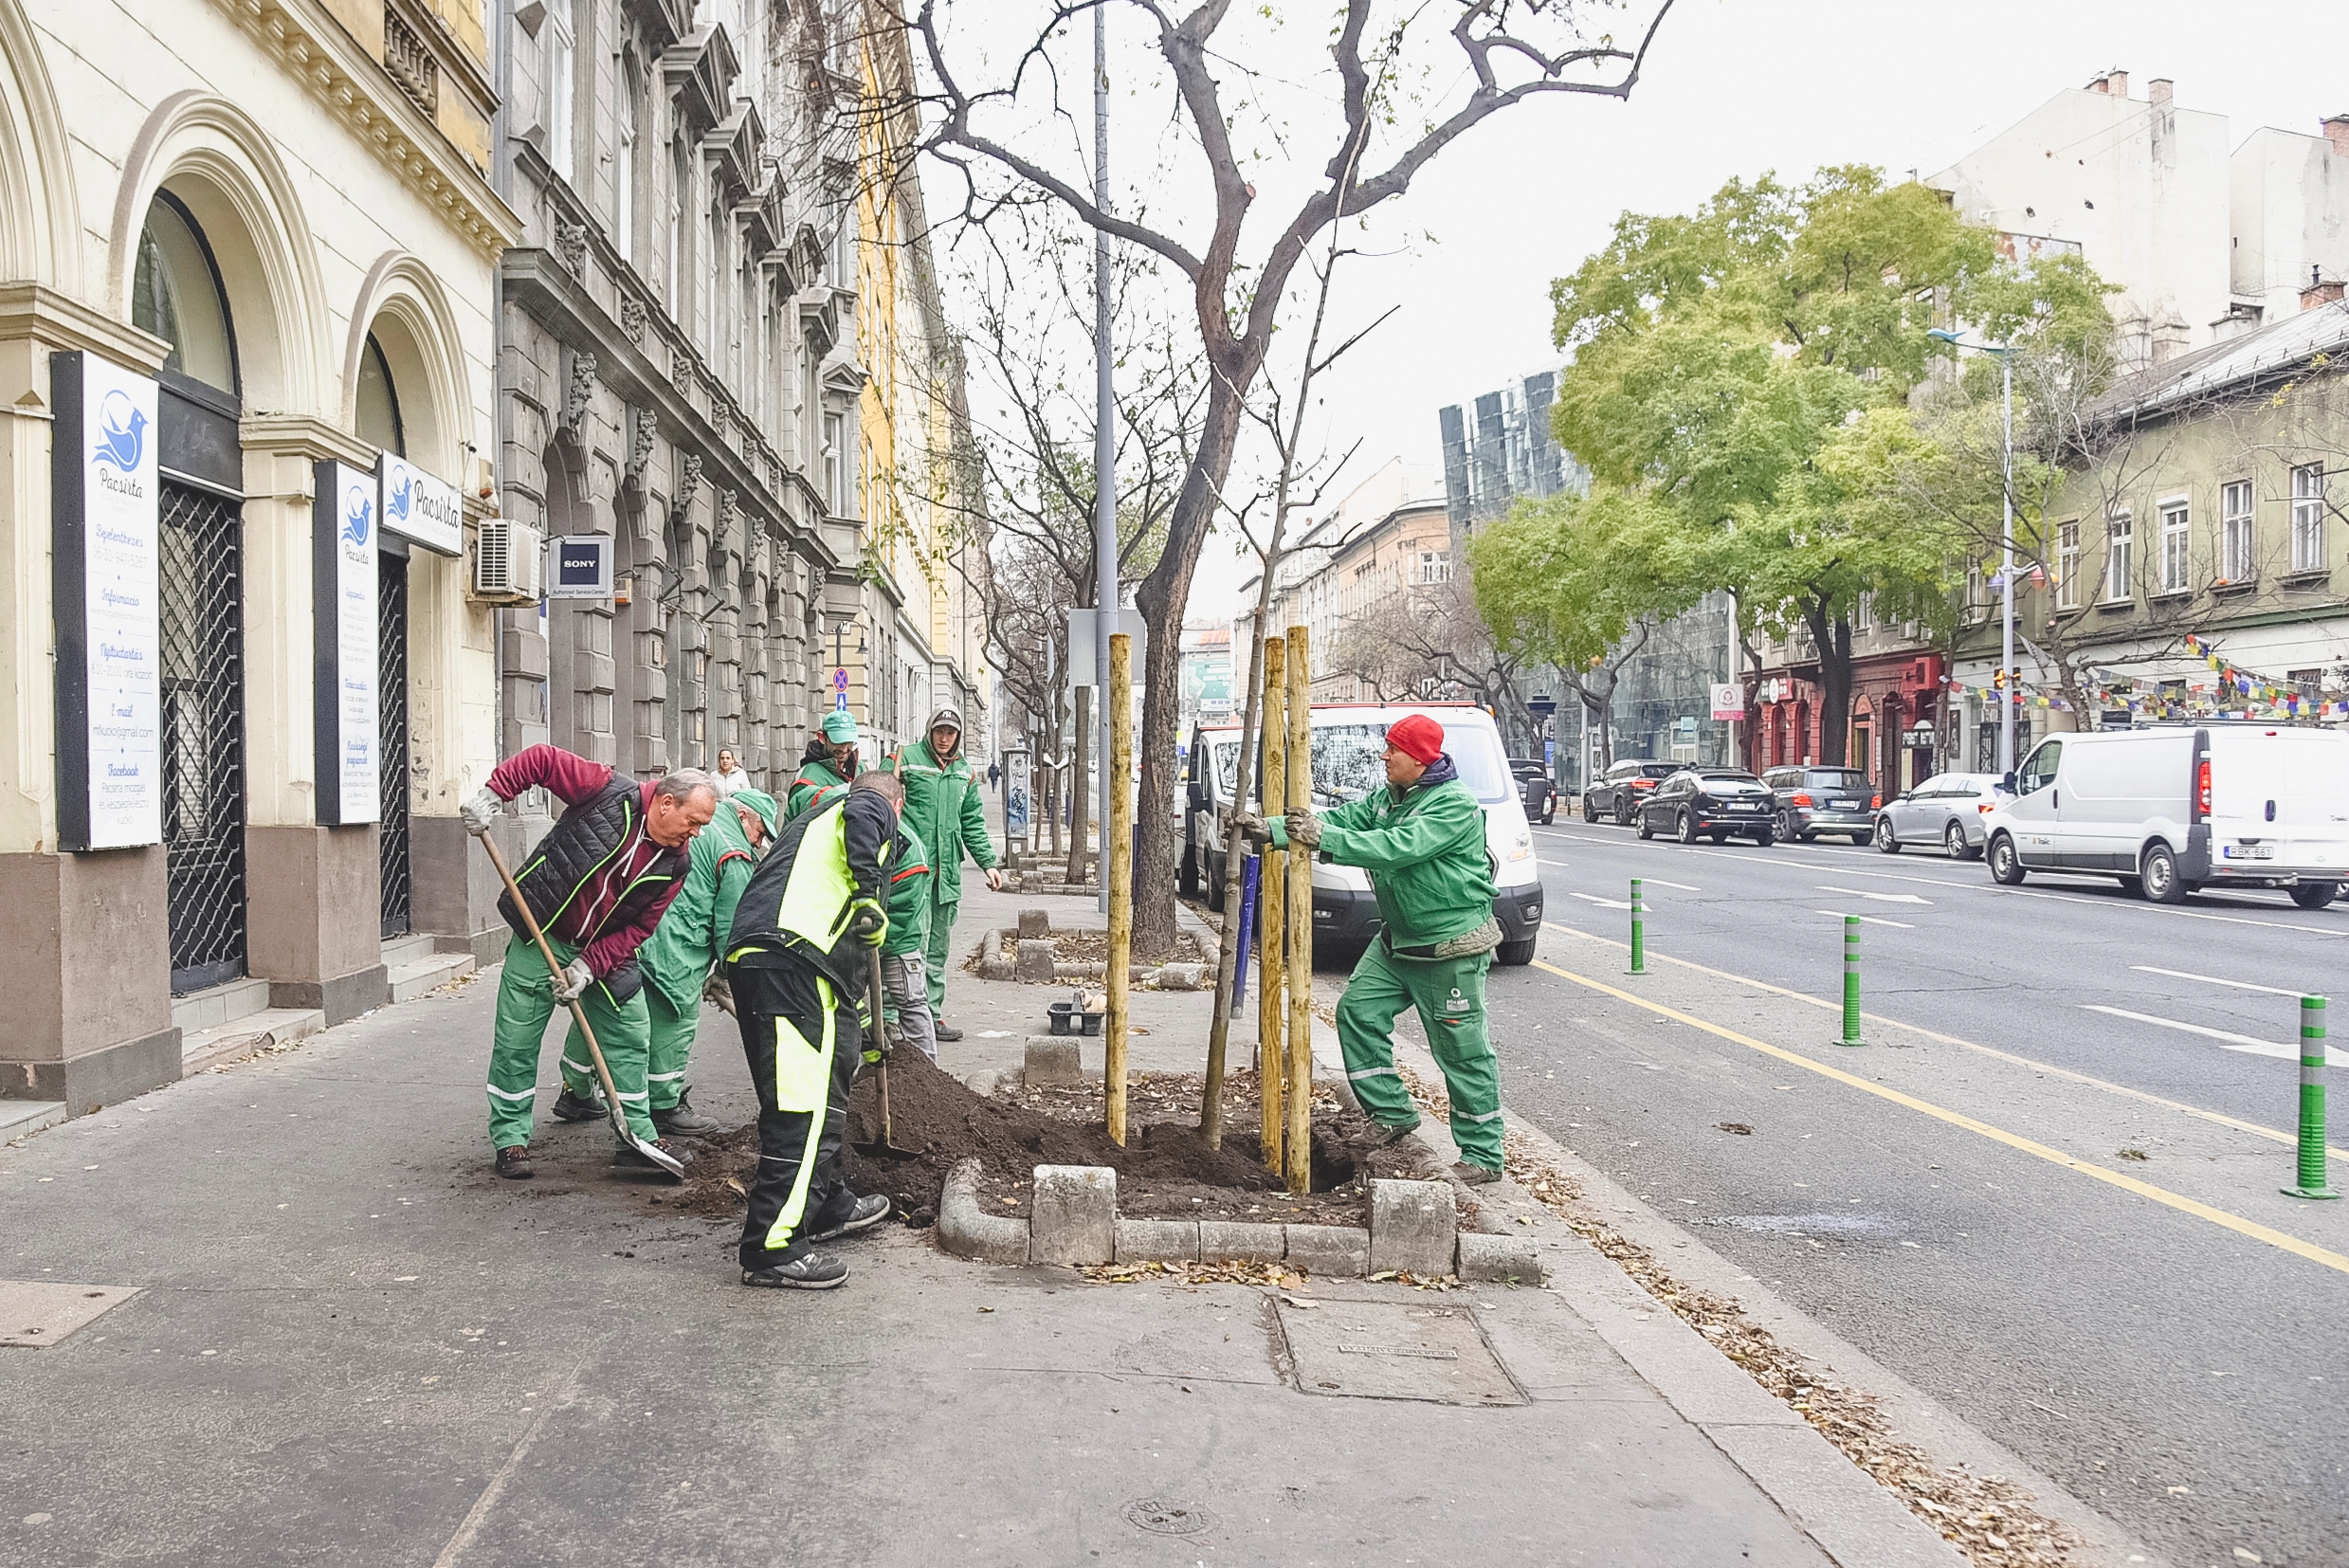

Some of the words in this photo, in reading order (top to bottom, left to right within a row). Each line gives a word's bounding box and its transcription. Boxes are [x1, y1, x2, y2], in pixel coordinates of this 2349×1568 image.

[100, 467, 143, 499] Pacsirta
[414, 479, 460, 529] Pacsirta
[111, 702, 134, 718] E-mail
[107, 762, 139, 777] Facebook
[2231, 848, 2271, 857] RBK-661
